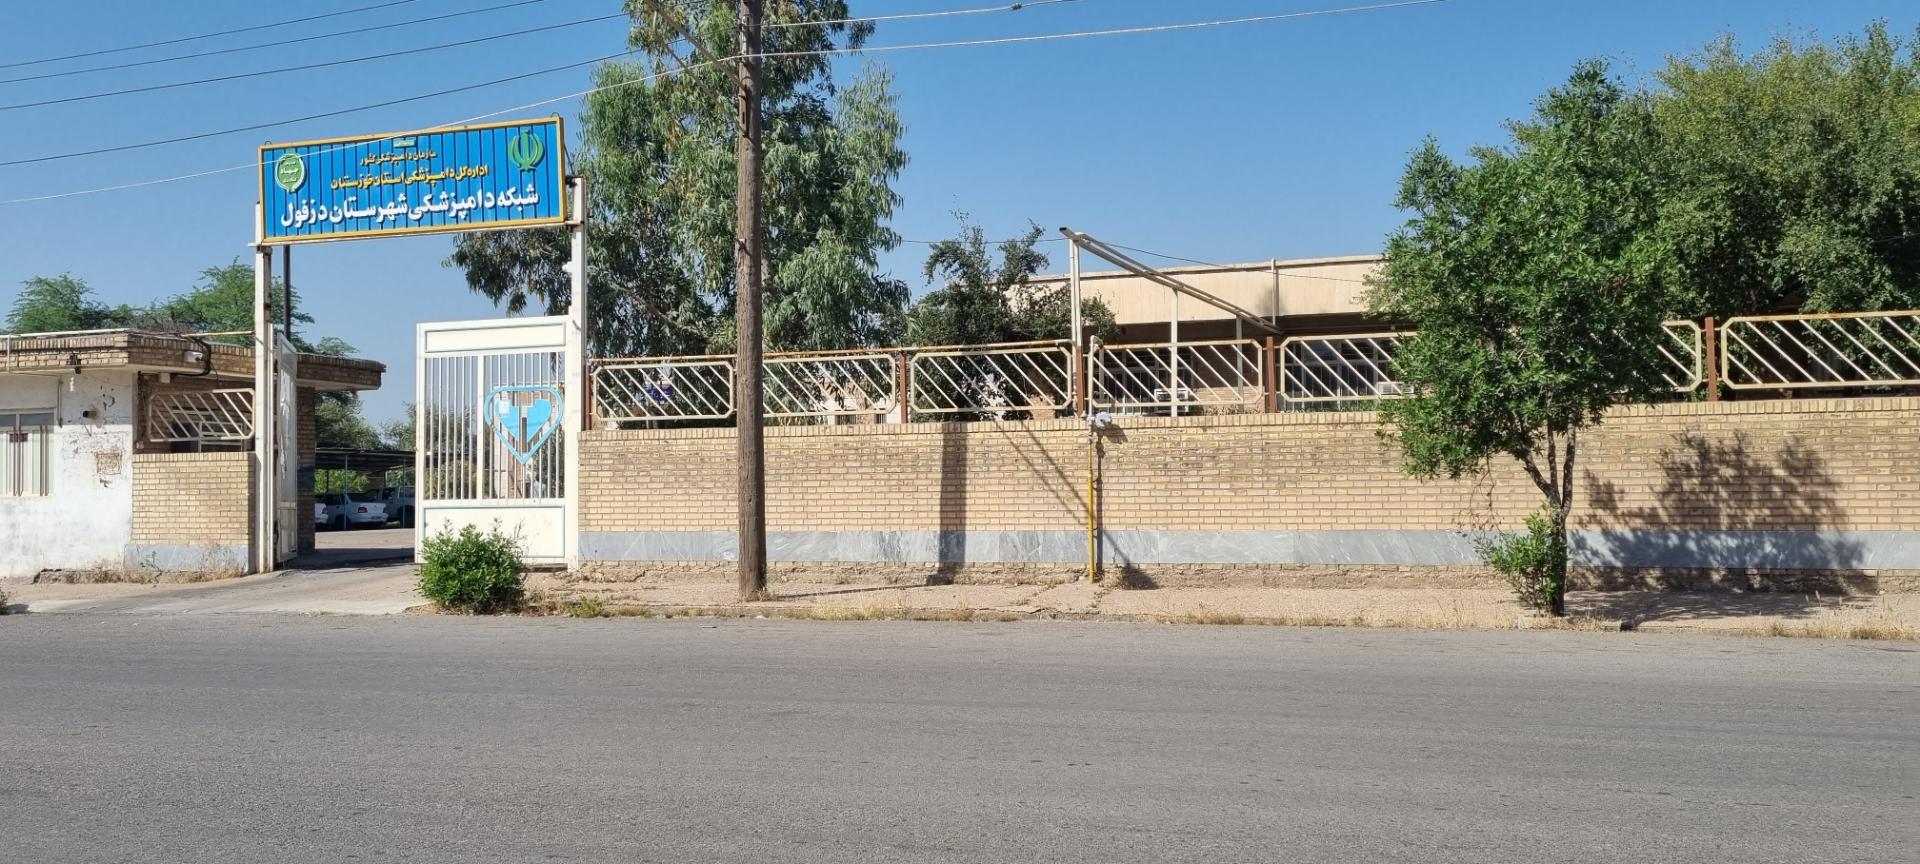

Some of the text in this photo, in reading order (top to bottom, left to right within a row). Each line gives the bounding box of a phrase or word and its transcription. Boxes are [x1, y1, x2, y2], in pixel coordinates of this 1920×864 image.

[330, 173, 375, 190] خوزستان
[374, 172, 404, 185] استان
[404, 166, 455, 187] دامپزشکی
[281, 184, 539, 228] شبکه دامپزشکی شهرستان دزفول
